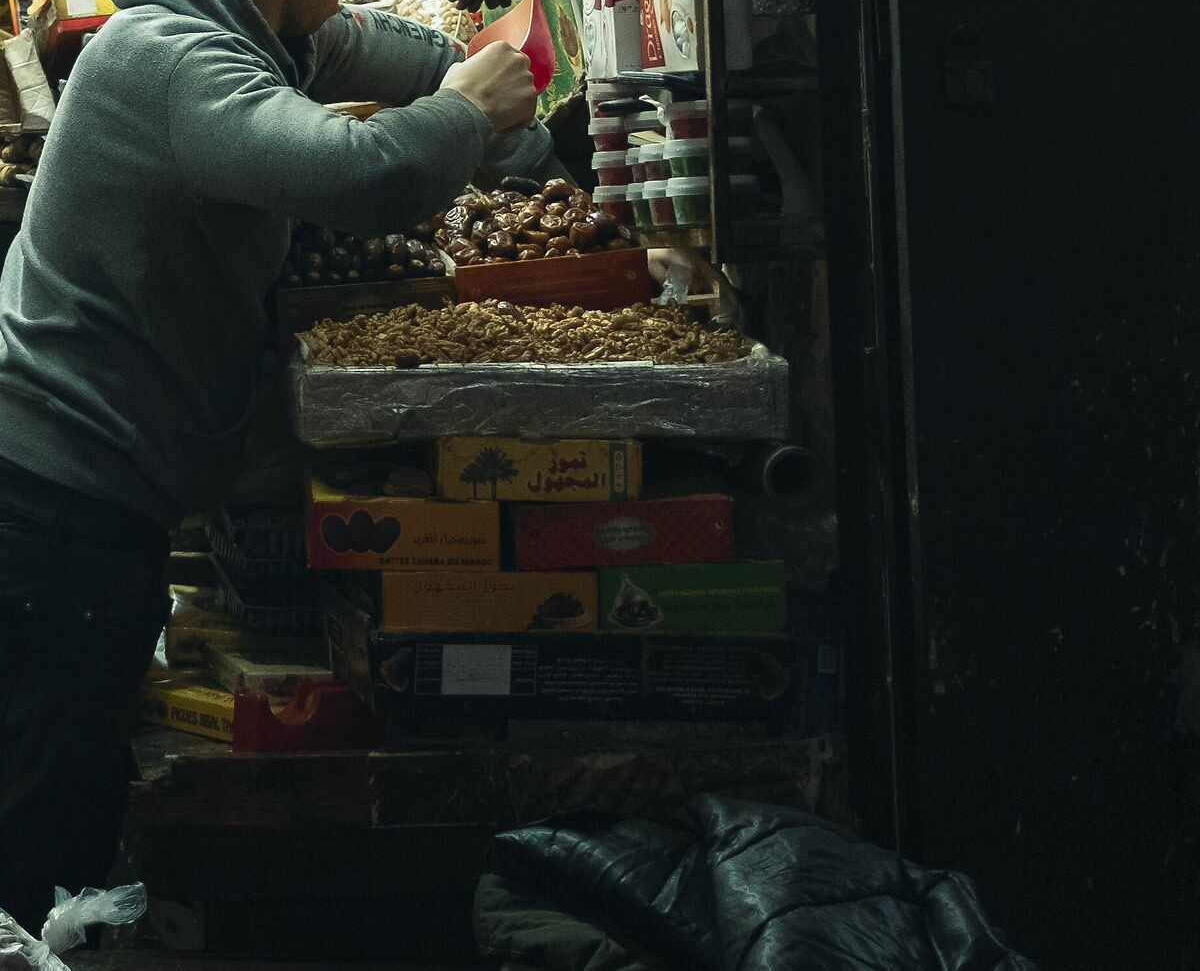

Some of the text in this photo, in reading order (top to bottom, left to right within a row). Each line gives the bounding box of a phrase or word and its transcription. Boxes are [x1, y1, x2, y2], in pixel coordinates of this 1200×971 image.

[547, 449, 587, 474] تمور
[527, 471, 606, 493] المجهول
[462, 557, 493, 566] MAROC
